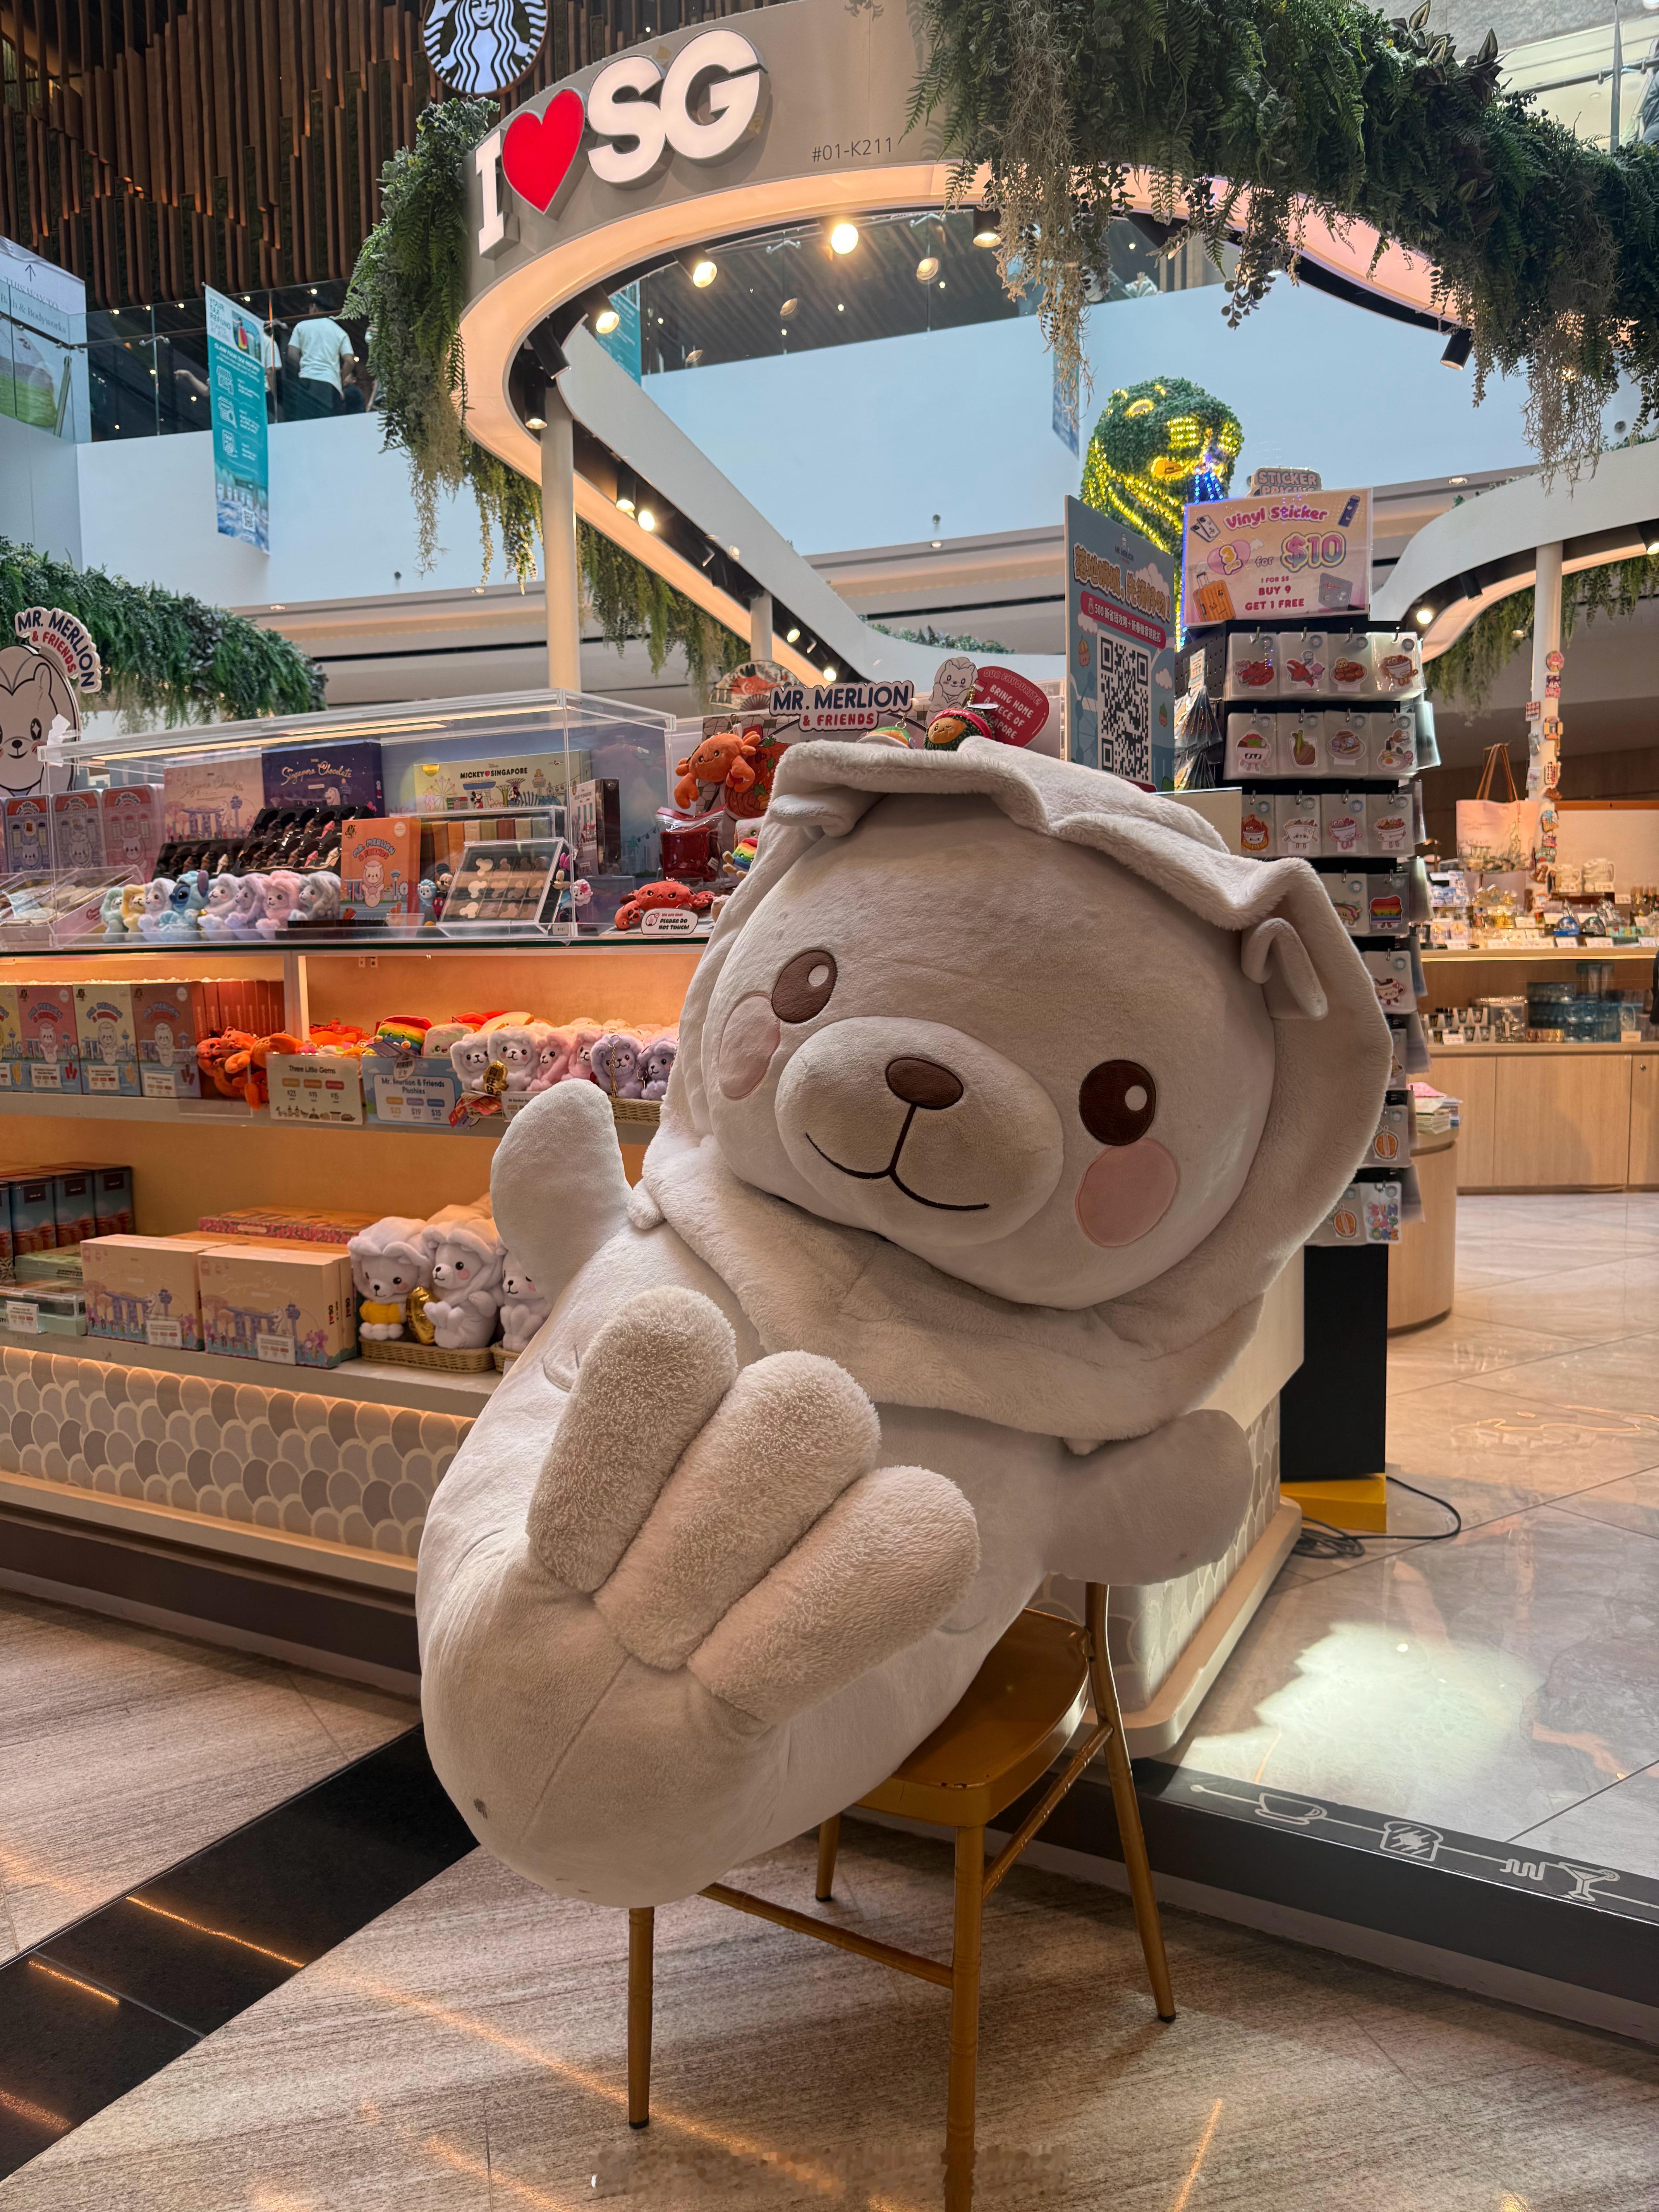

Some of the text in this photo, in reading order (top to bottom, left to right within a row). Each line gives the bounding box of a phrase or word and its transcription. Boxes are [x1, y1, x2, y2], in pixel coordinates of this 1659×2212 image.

[587, 29, 761, 183] SG
[812, 137, 891, 162] #01-K211
[1258, 471, 1317, 486] STICKER
[1225, 505, 1329, 529] Vinyl Sticker
[1255, 533, 1345, 571] for $10
[1259, 586, 1291, 596] BUY 9
[1095, 603, 1104, 617] 500
[1245, 599, 1304, 611] GET 1 FREE
[18, 610, 94, 687] MR. MERLION
[32, 630, 77, 673] & FRIENDS
[774, 685, 909, 711] MR. MERLION
[983, 670, 1043, 706] OUR FAVOURITE!
[989, 684, 1034, 719] BRING HOME
[803, 713, 874, 726] & FRIENDS
[994, 702, 1014, 721] IECE
[1013, 717, 1025, 728] OF
[280, 760, 352, 786] Singapore Chocolate
[460, 768, 528, 779] MICKEY SINGAPORE
[366, 838, 396, 855] MERLION
[423, 1079, 445, 1087] Friends
